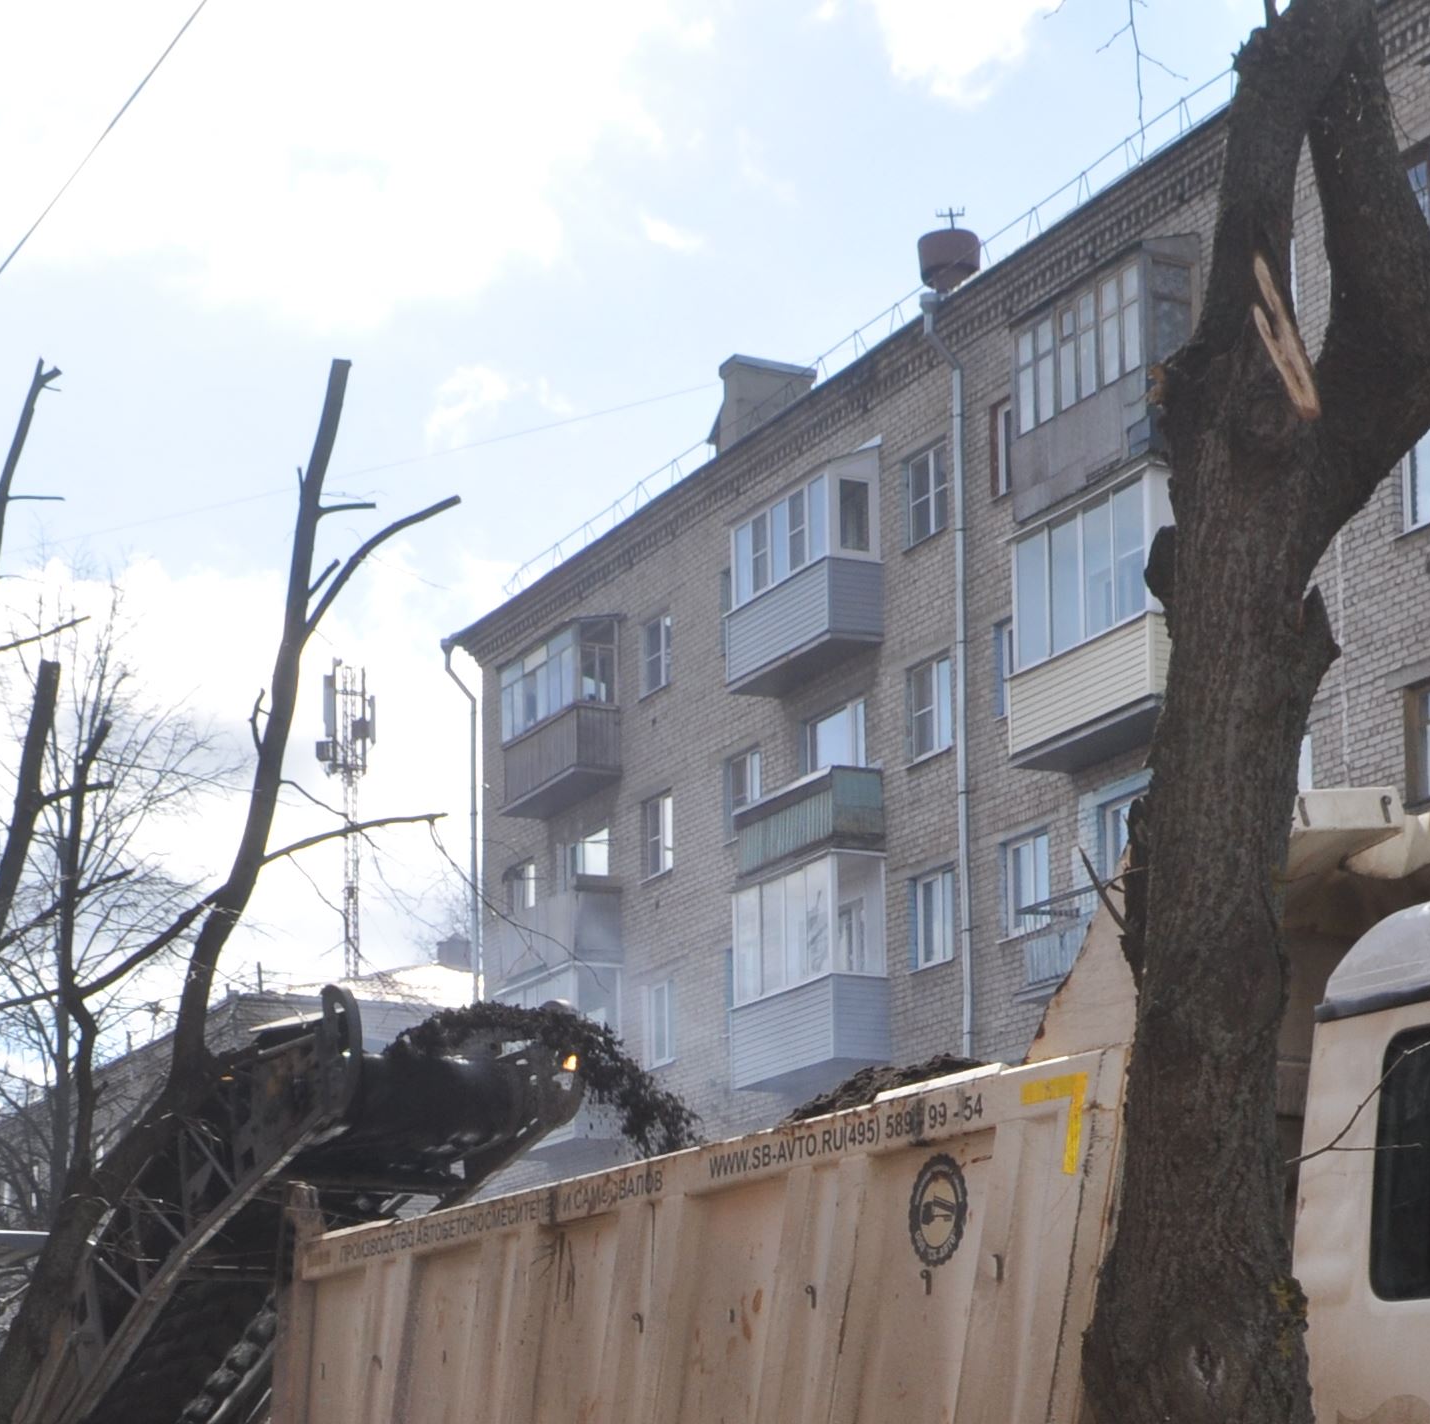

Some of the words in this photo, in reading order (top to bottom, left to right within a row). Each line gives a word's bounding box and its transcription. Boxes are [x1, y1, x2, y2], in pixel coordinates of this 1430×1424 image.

[928, 1101, 947, 1129] 99
[963, 1093, 983, 1121] 54
[339, 1230, 413, 1262] ПРОИЗВОДСТВО
[415, 1194, 558, 1244] АВТОБЕТОНОСМЕСИТЕЛЕ
[562, 1191, 571, 1212] И
